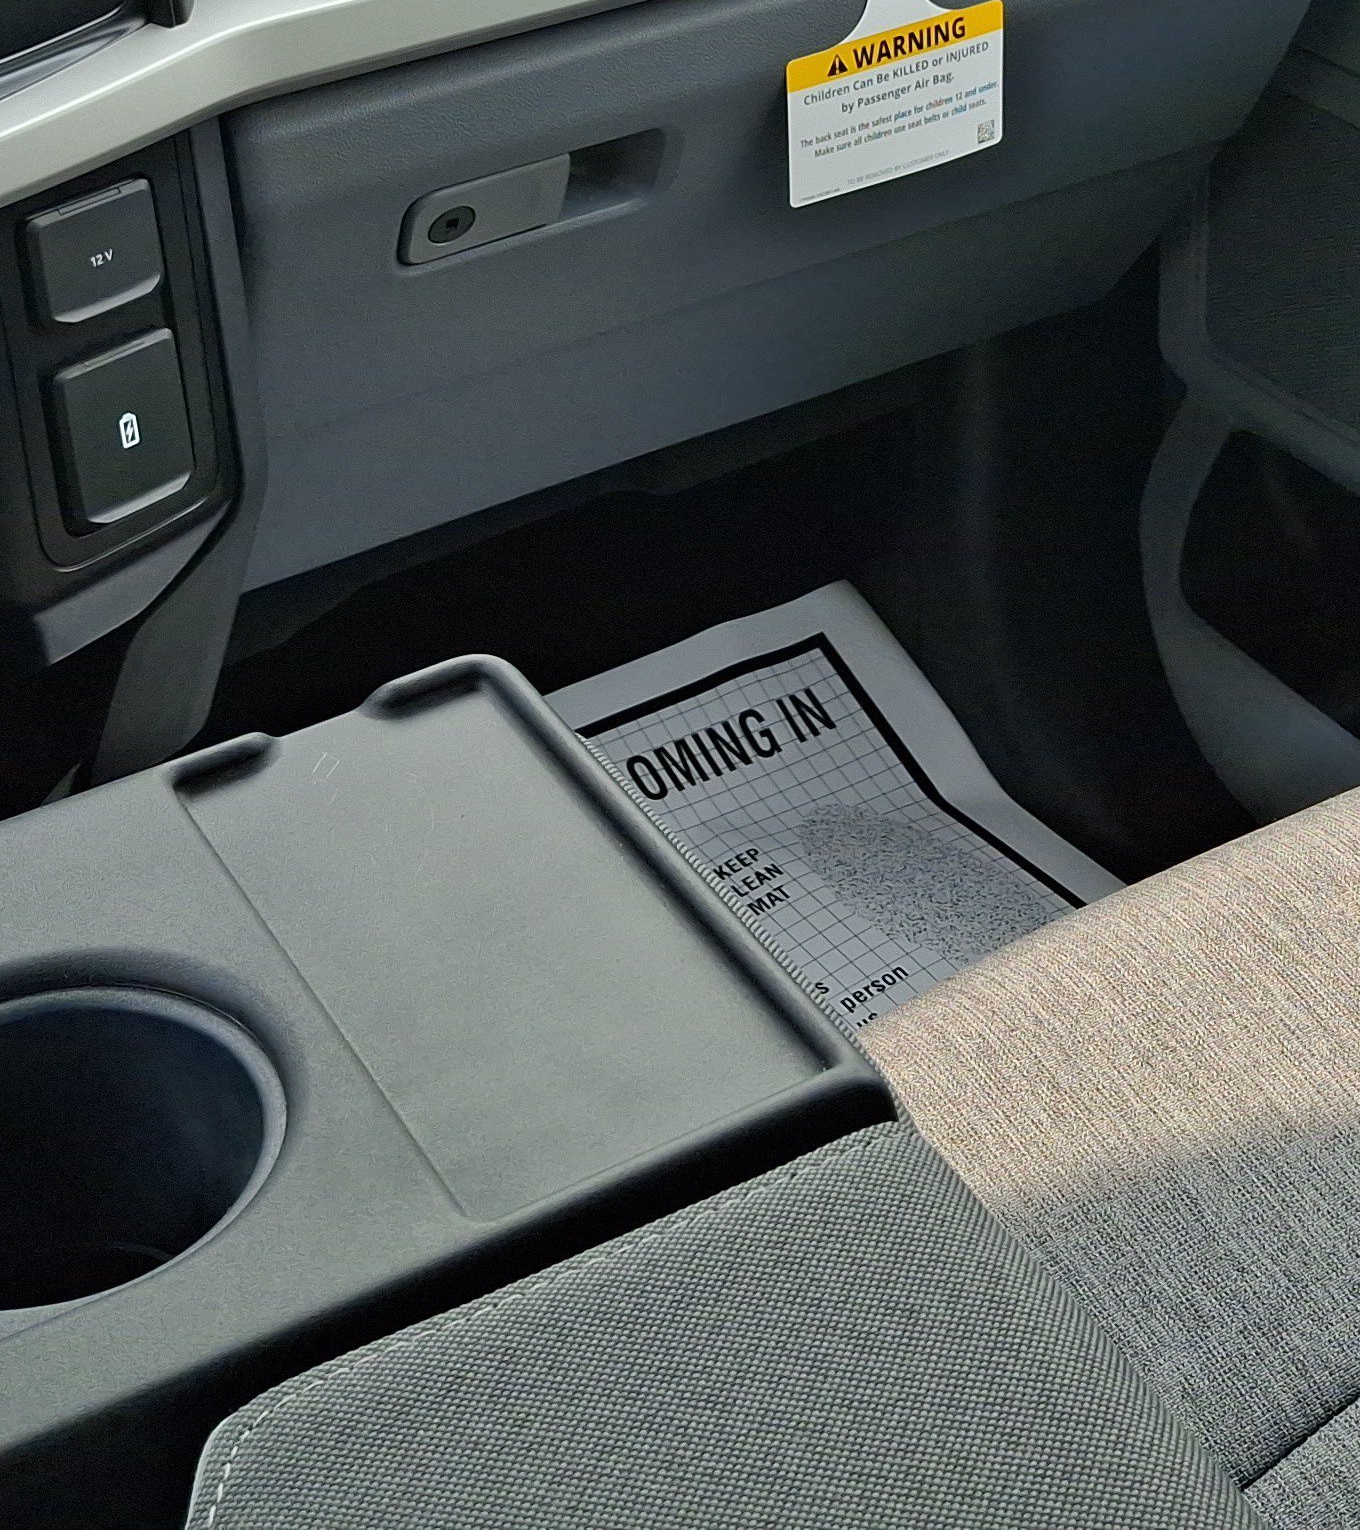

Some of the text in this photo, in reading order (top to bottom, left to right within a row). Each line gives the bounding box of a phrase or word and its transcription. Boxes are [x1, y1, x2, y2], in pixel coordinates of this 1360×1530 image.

[853, 17, 966, 69] WARNING
[804, 41, 989, 106] Children Can Be KILLED or INJURED
[842, 71, 954, 113] by Passenger Air Bag.
[625, 687, 836, 801] OMING IN
[713, 848, 759, 880] KEEP
[730, 864, 784, 897] LEAN
[747, 885, 790, 916] MAT
[840, 966, 908, 1013] person
